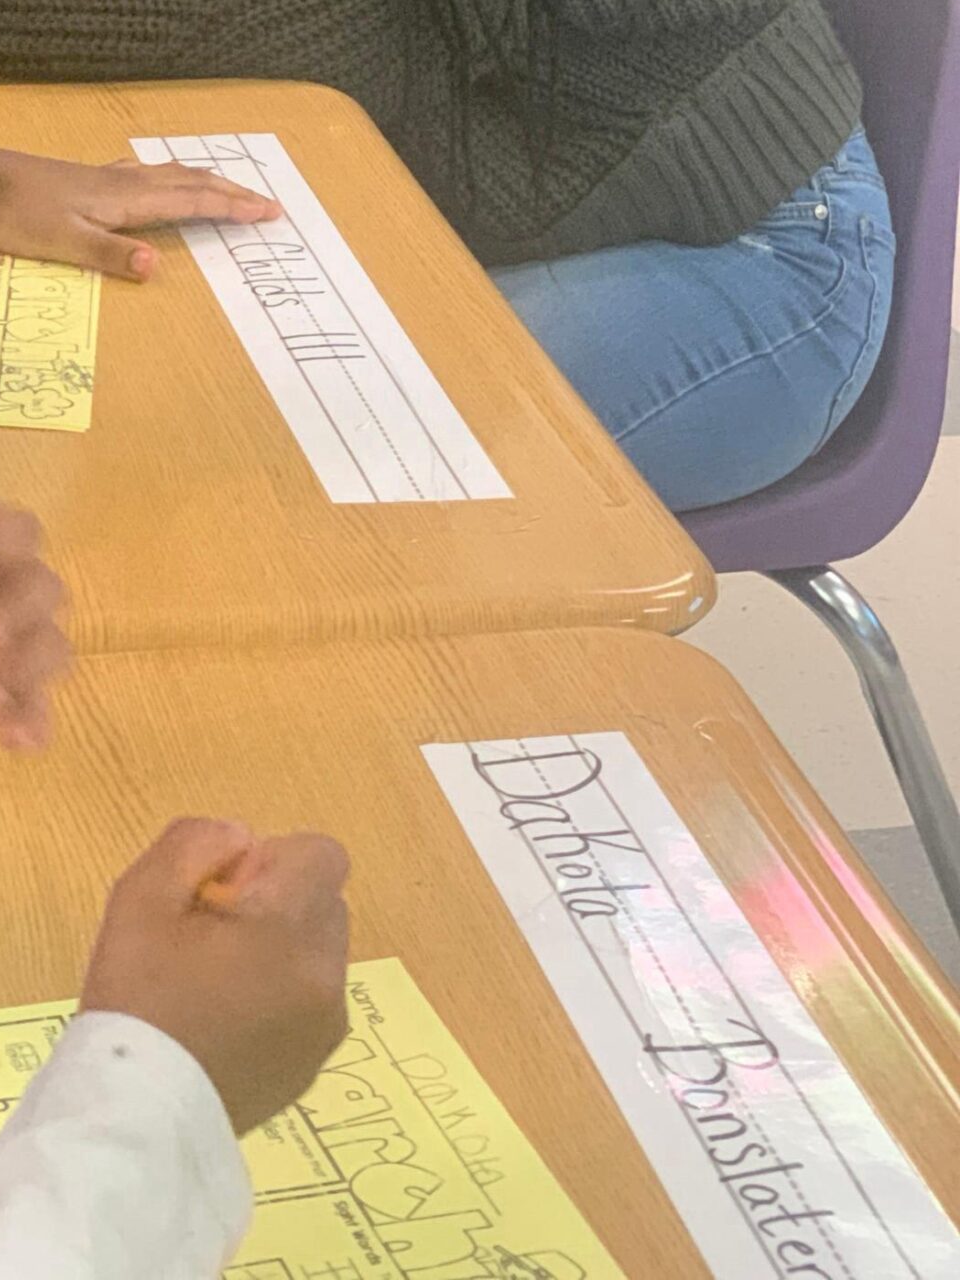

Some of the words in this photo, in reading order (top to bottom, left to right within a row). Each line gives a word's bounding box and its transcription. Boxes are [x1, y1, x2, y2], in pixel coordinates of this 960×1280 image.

[348, 982, 385, 1026] Name
[333, 1200, 358, 1228] Sight
[352, 1229, 382, 1266] Words
